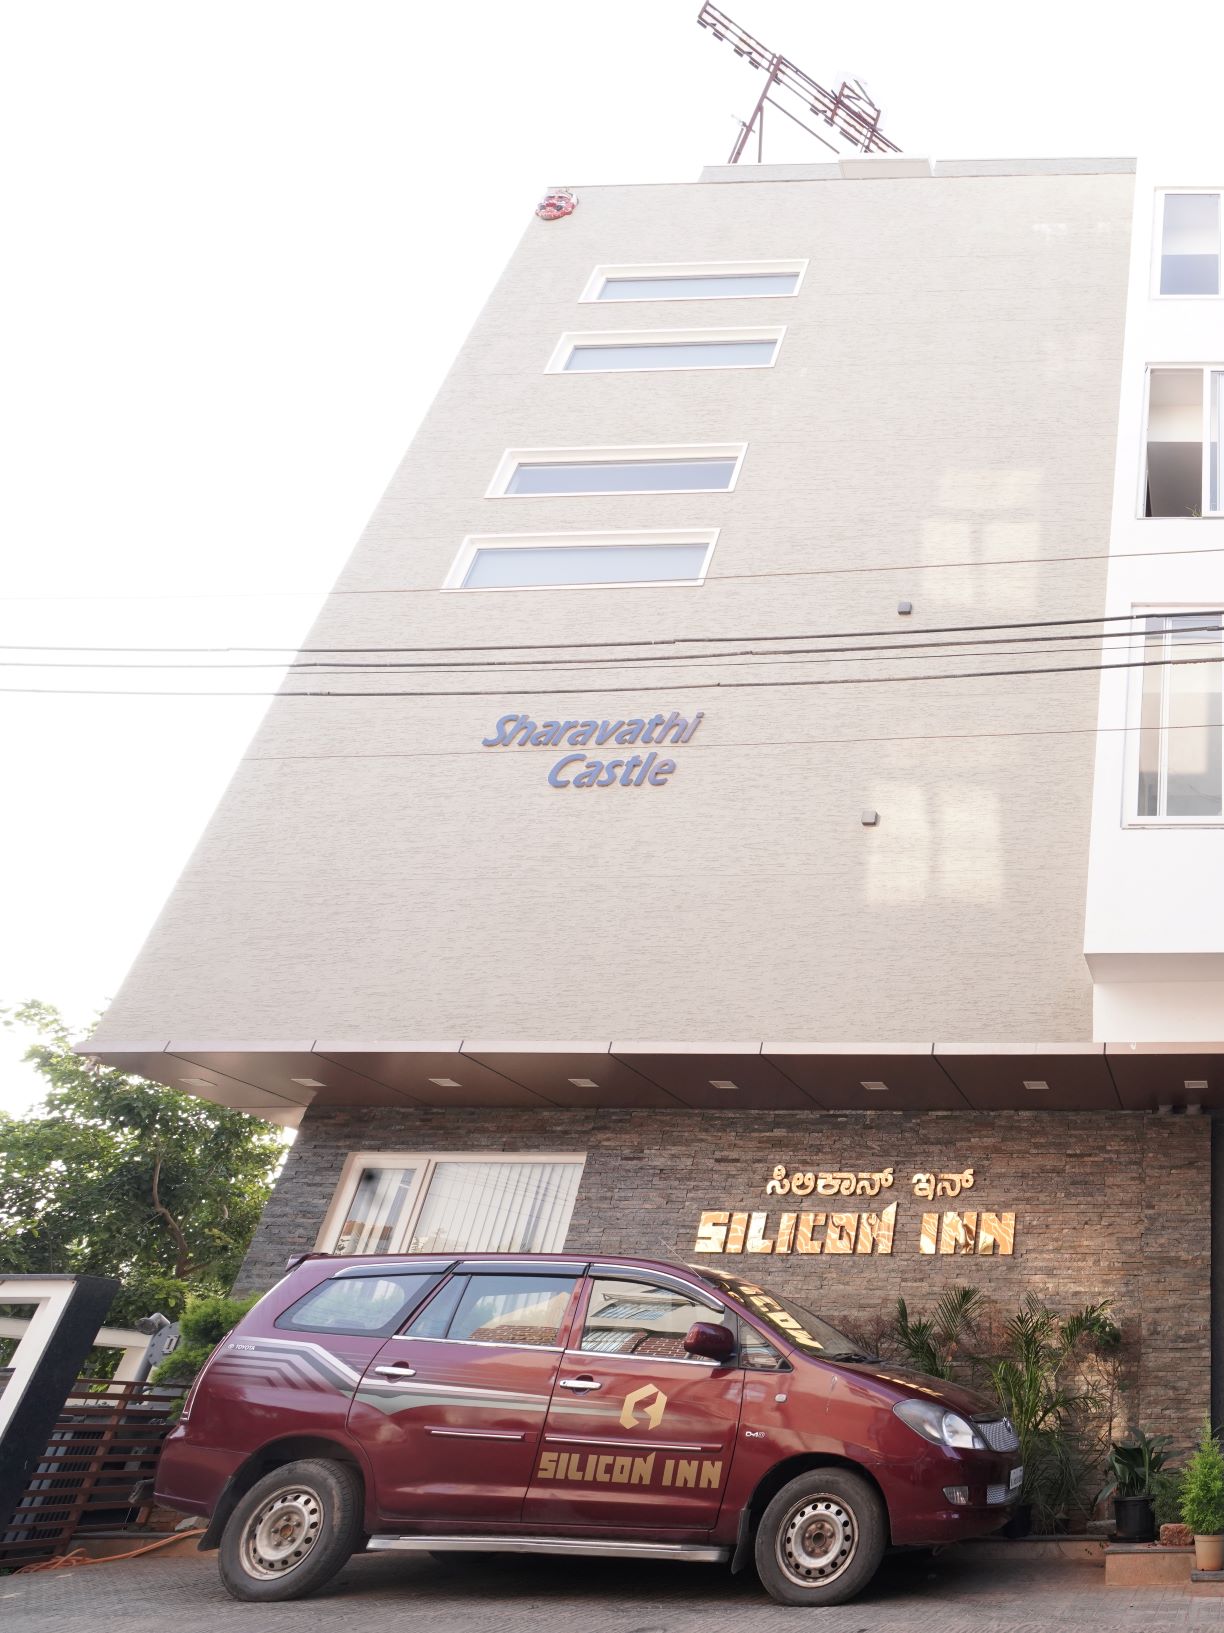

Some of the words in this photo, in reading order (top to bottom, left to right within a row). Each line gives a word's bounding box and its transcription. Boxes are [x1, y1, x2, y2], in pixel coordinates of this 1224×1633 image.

[481, 711, 704, 747] Sharavathi
[547, 752, 676, 788] Castle
[766, 1164, 894, 1196] ಸಿಲಿಕಾನ್
[911, 1168, 974, 1200] ಇನ್
[694, 1201, 899, 1254] SILICON
[919, 1210, 1017, 1255] INN
[537, 1451, 656, 1485] SILICON
[662, 1459, 723, 1489] INN
